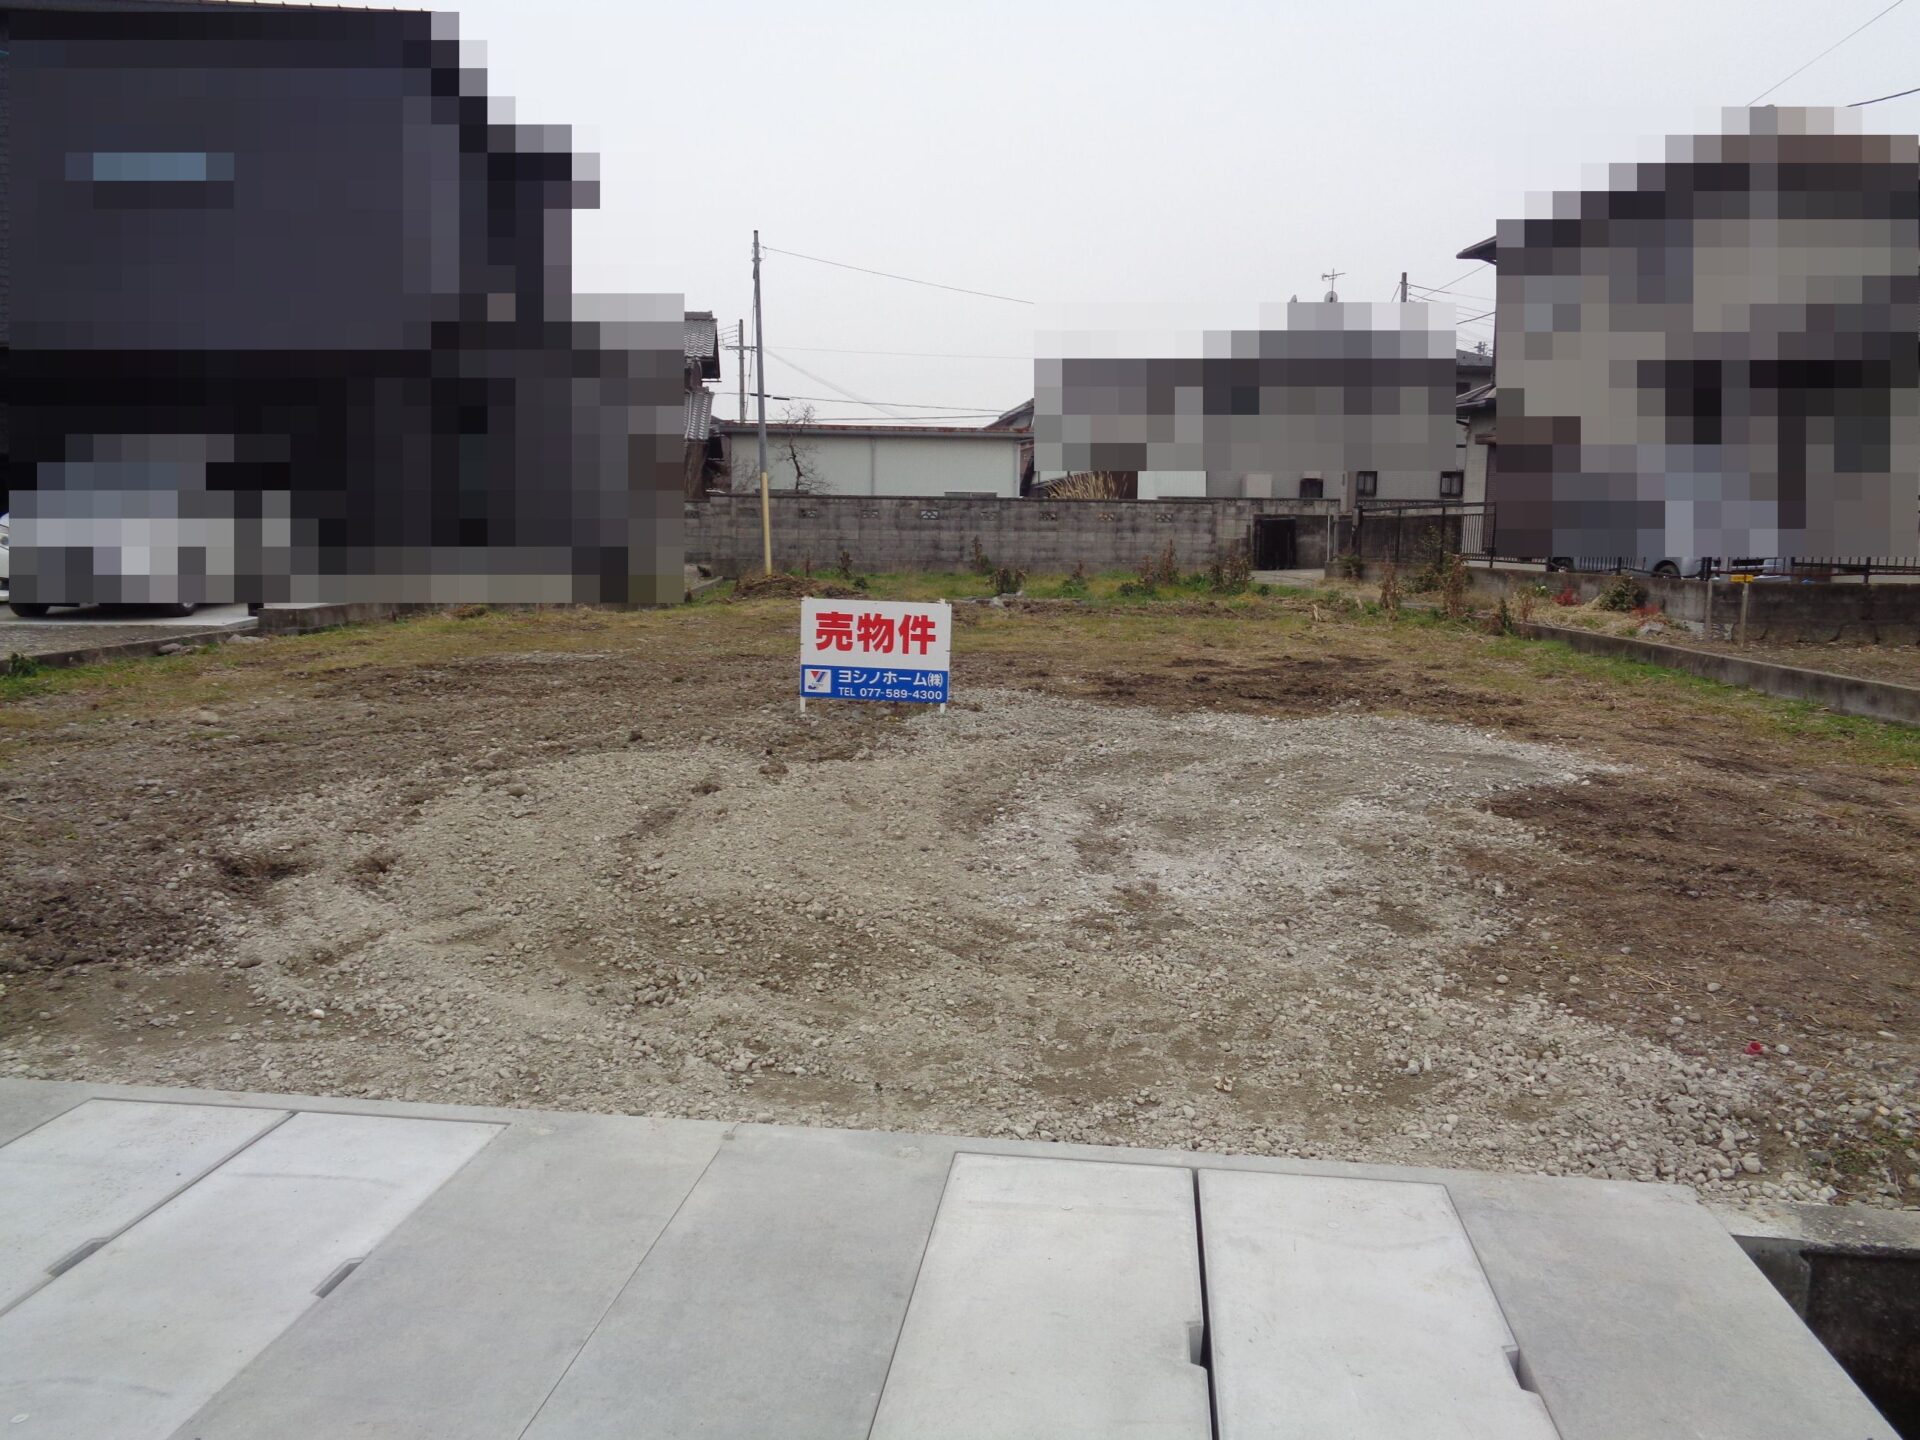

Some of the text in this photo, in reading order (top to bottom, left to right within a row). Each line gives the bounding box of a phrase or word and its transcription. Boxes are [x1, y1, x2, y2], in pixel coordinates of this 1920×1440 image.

[815, 611, 936, 655] 売物件
[839, 687, 942, 700] TEL 077-589-4300
